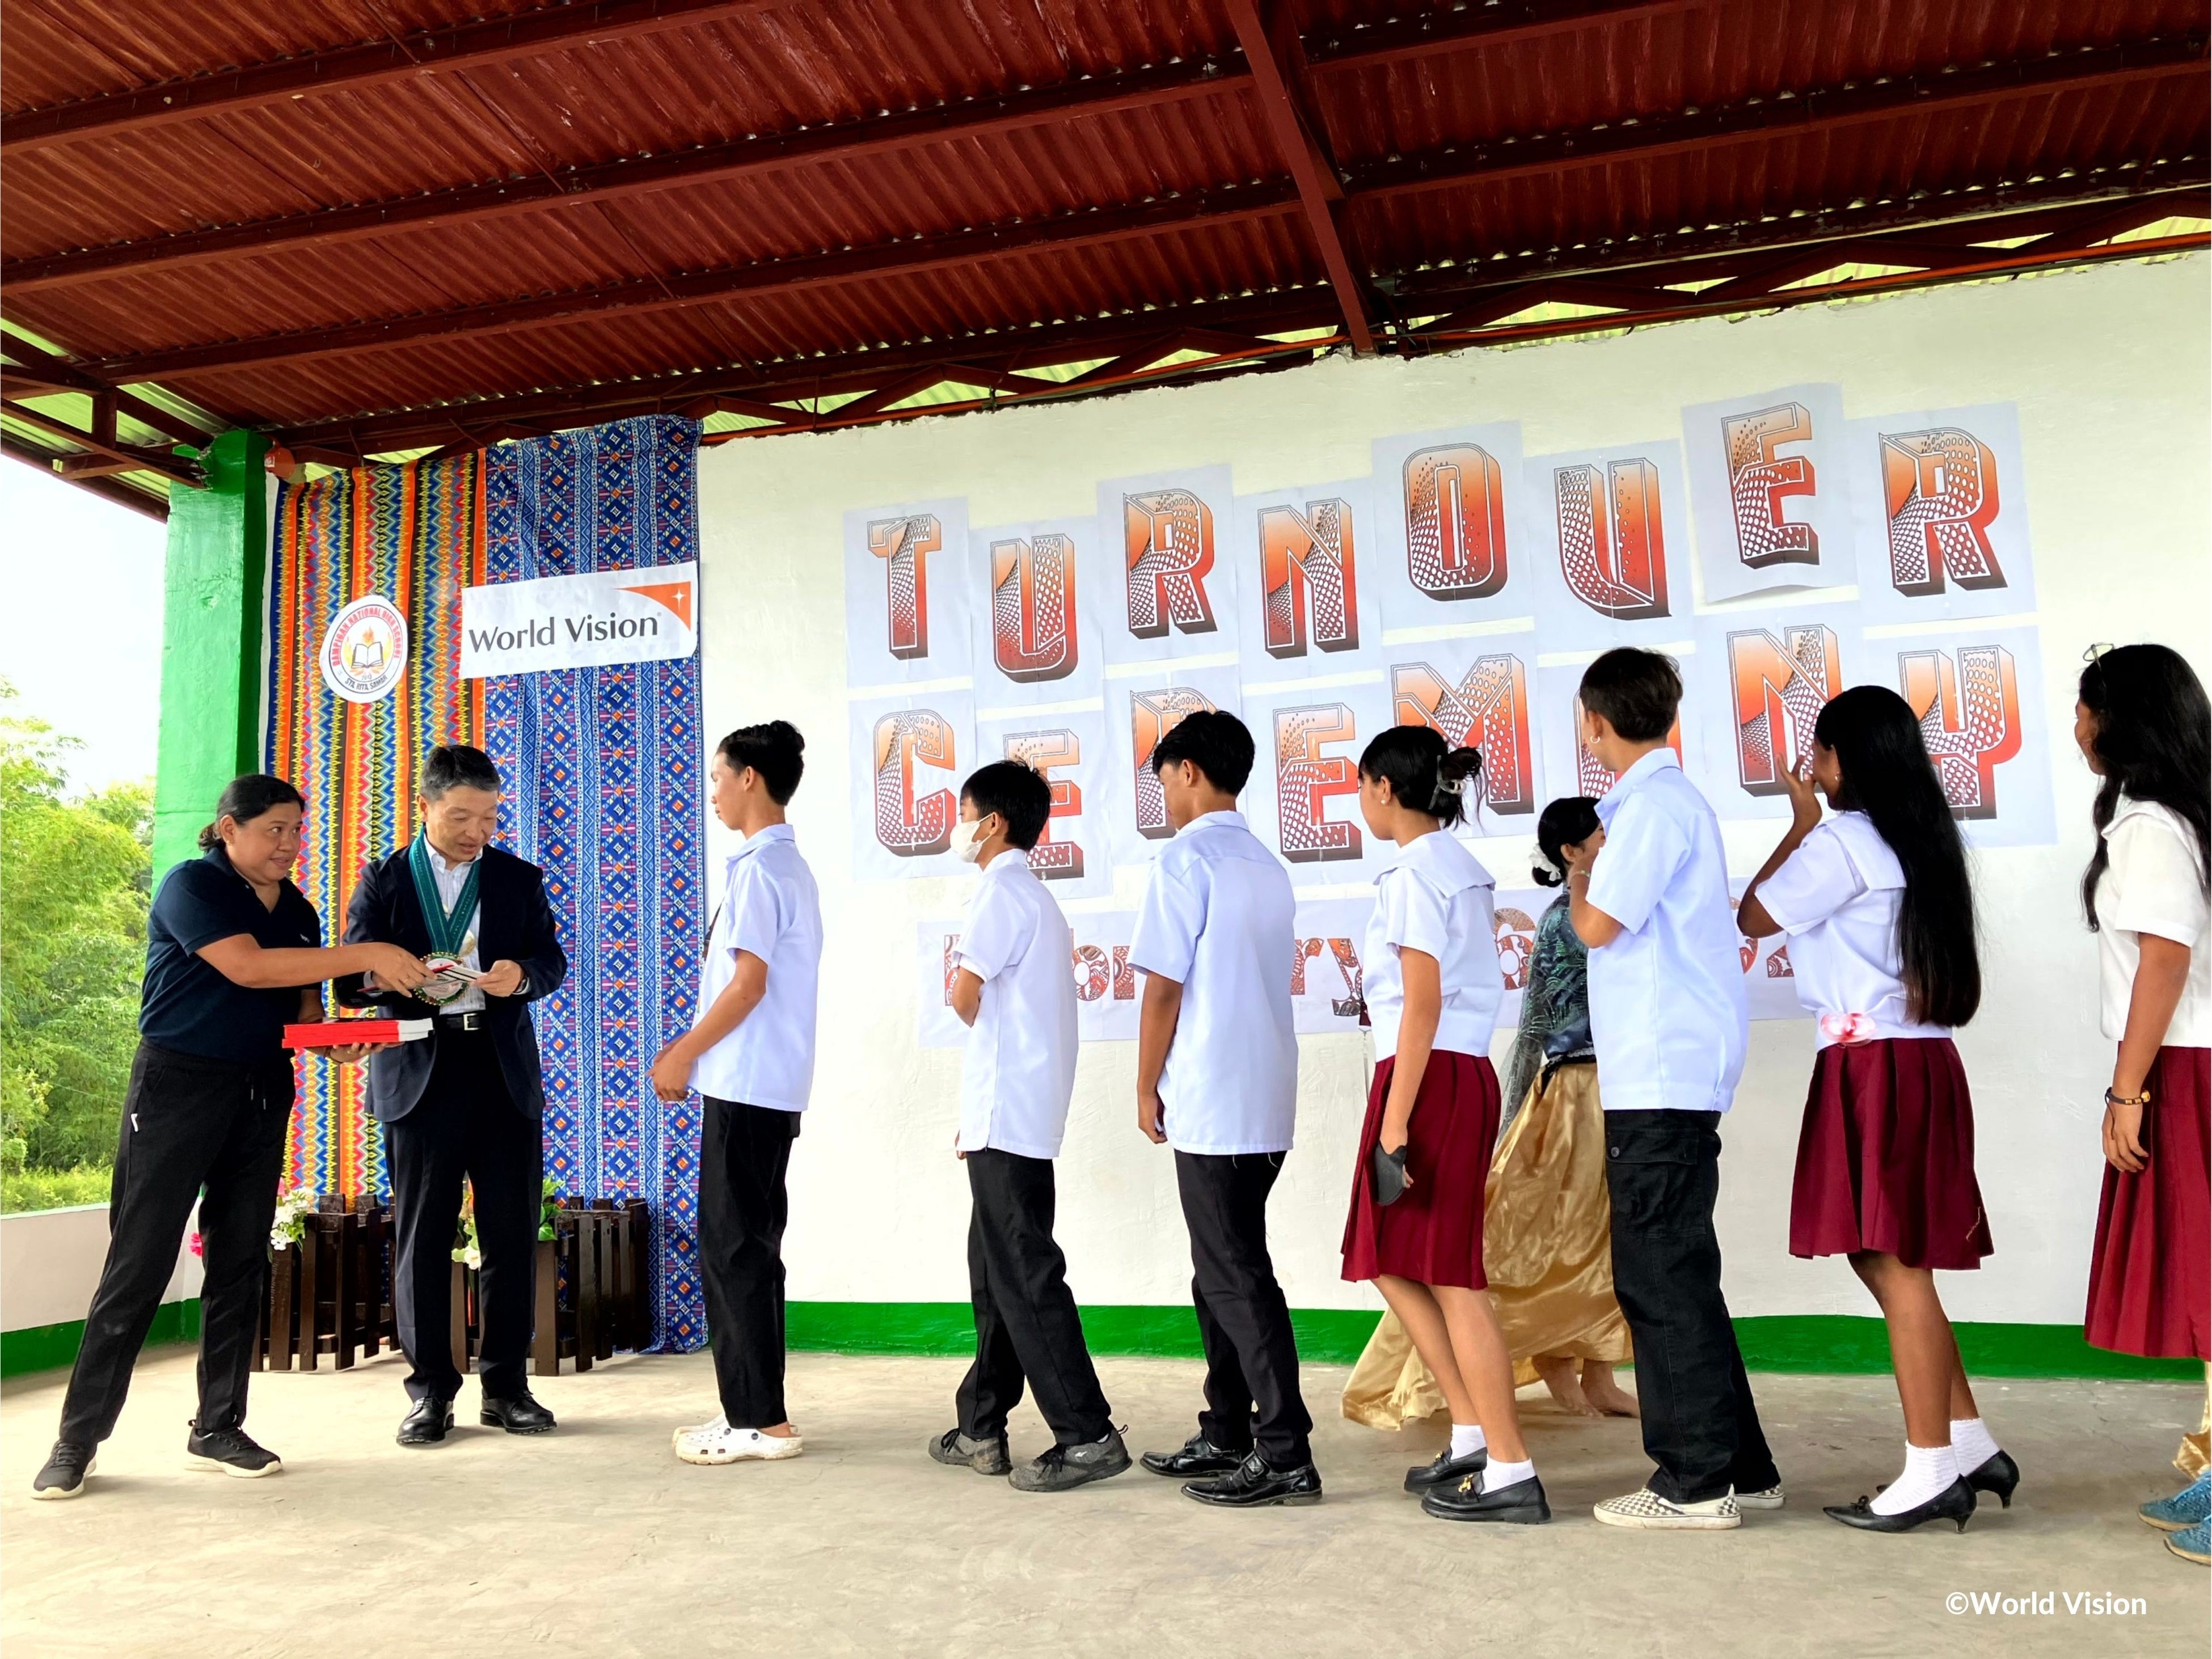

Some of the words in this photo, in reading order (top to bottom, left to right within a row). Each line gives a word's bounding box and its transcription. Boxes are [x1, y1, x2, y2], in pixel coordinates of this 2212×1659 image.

[348, 607, 380, 624] NATIONAL
[381, 610, 396, 626] HIGH
[392, 626, 402, 658] SCHOOL
[468, 617, 555, 653] World
[564, 612, 658, 643] Vision
[369, 675, 388, 689] SAMAR
